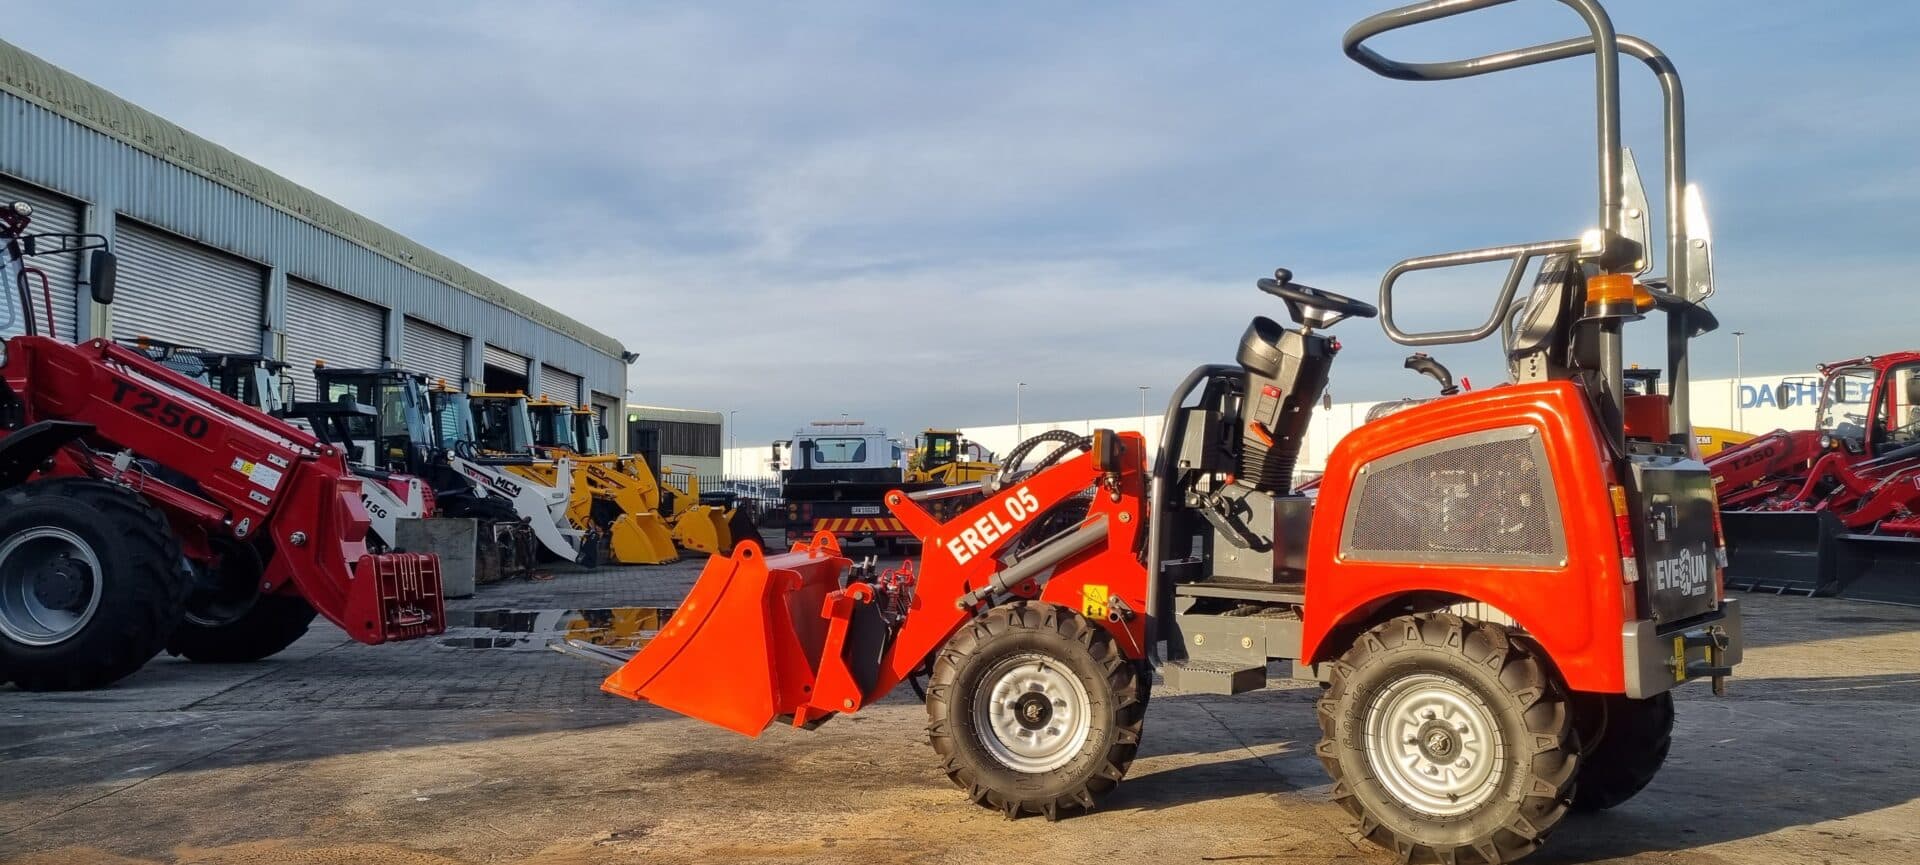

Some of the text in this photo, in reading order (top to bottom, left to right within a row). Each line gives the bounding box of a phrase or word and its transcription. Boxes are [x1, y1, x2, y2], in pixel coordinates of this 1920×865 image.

[112, 377, 208, 439] T250
[1732, 446, 1774, 470] T250
[496, 476, 522, 495] MCM
[946, 486, 1039, 566] EREL 05
